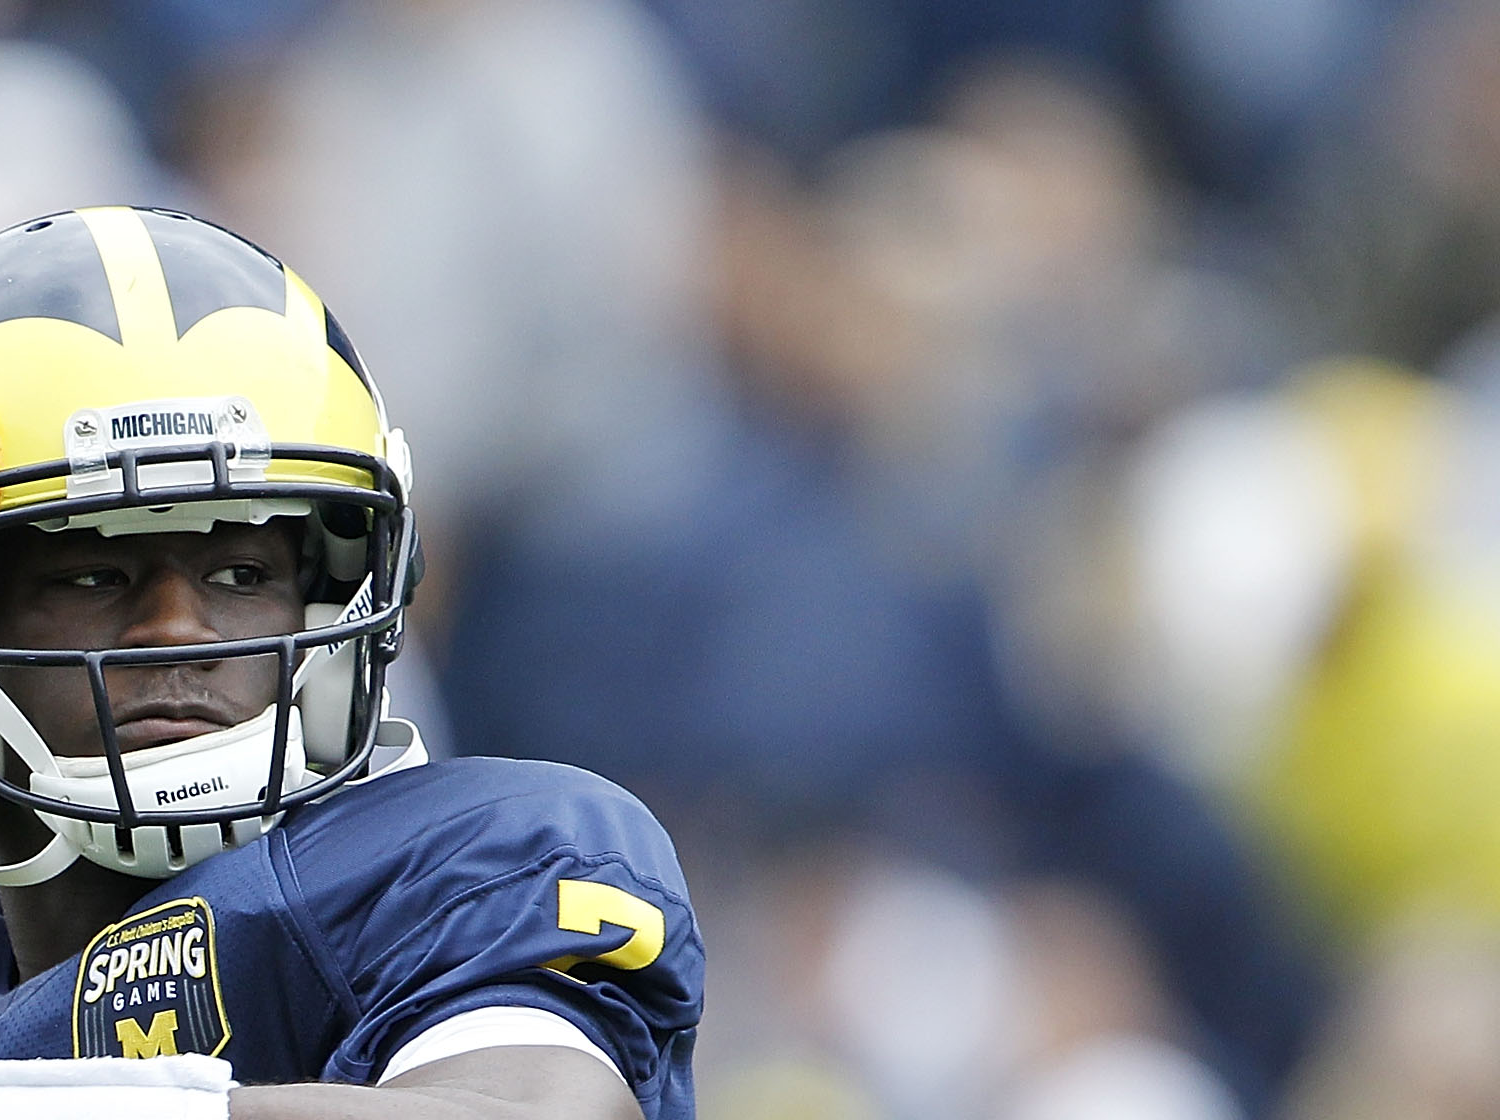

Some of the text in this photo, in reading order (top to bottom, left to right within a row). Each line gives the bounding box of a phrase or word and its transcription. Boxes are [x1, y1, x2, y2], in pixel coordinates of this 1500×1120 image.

[111, 412, 214, 441] MICHIGAN
[83, 926, 207, 1004] SPRING
[112, 980, 178, 1011] GAME
[114, 1009, 180, 1060] M
